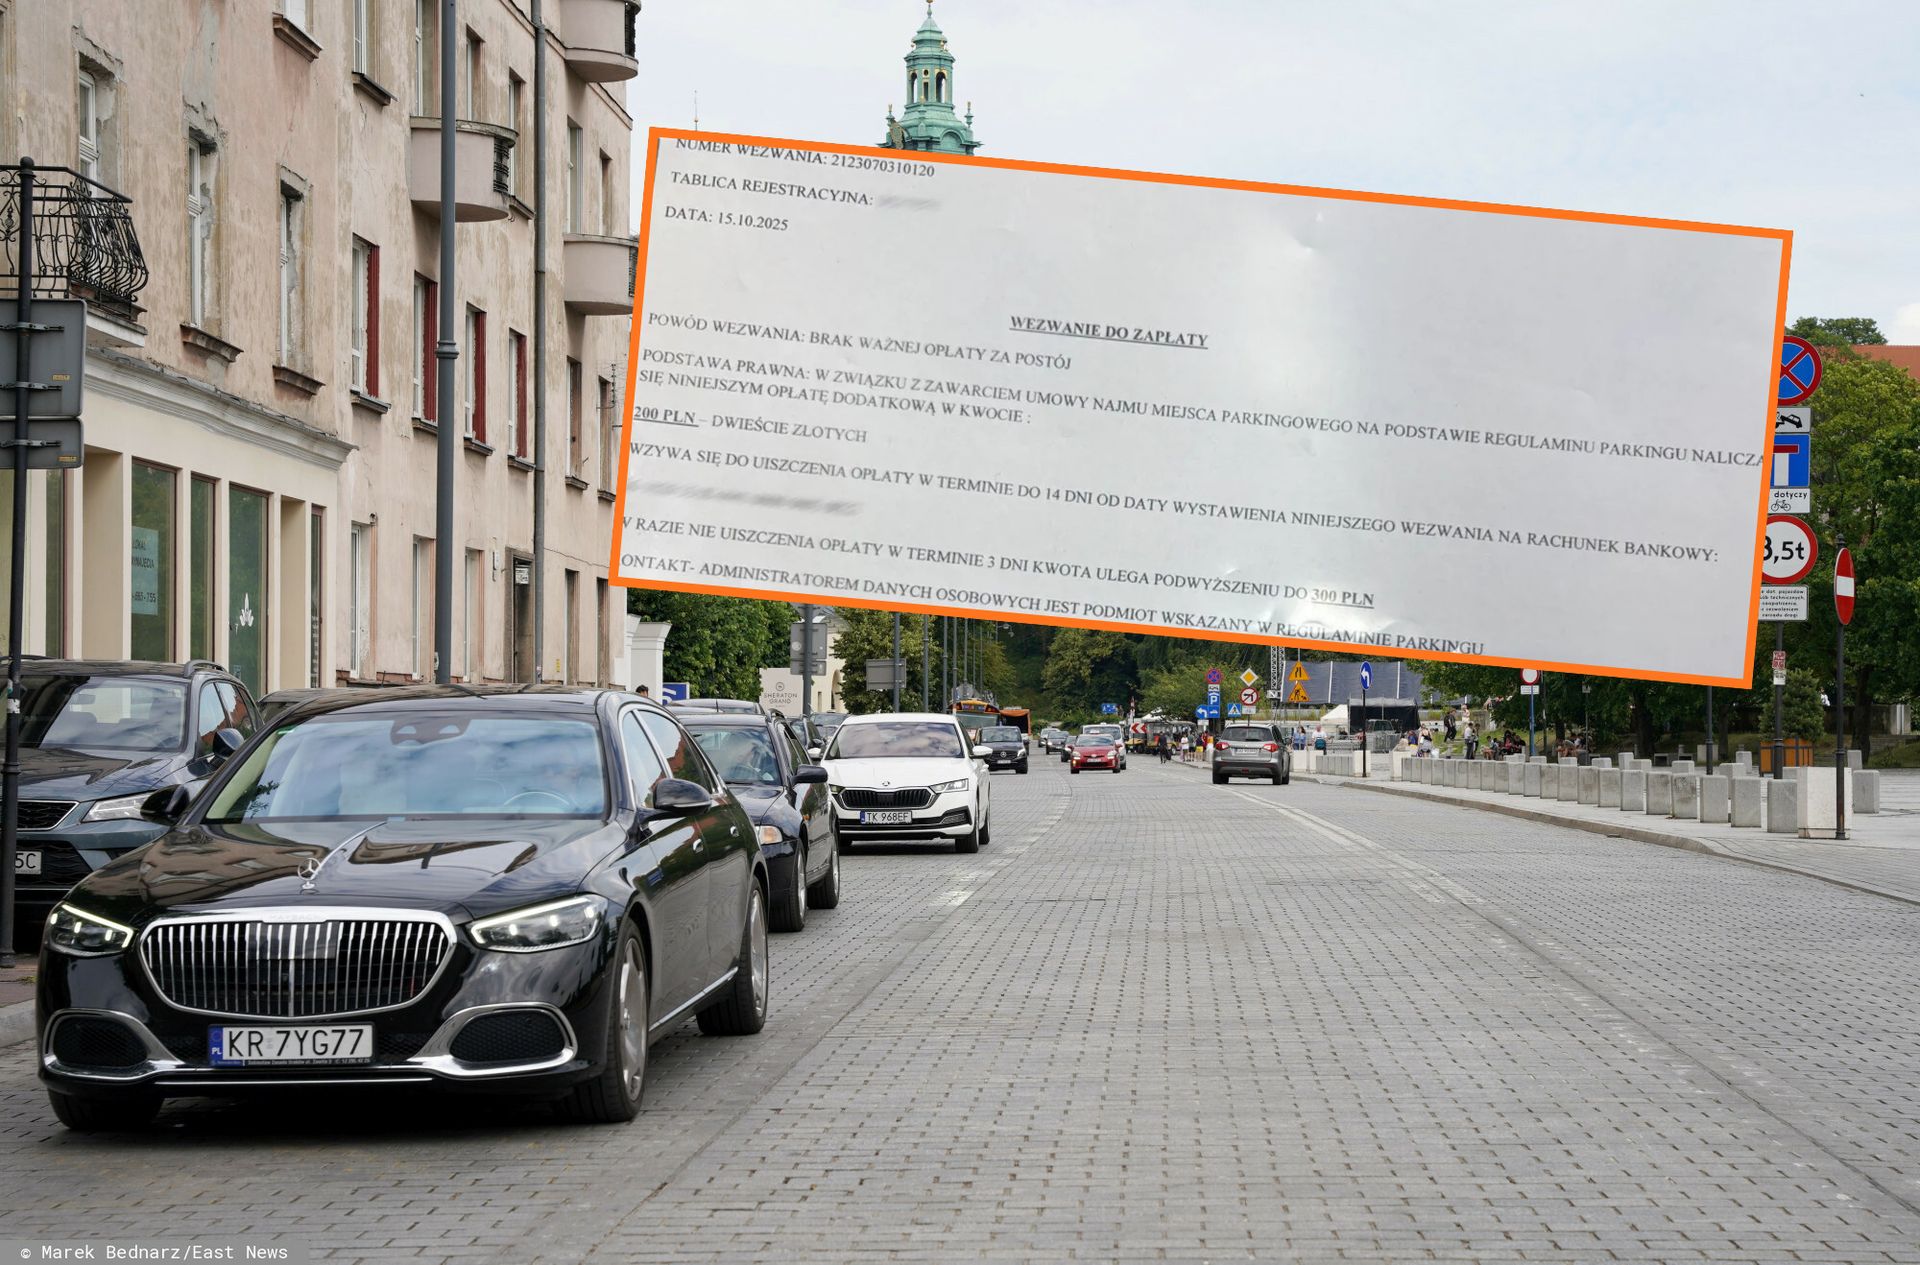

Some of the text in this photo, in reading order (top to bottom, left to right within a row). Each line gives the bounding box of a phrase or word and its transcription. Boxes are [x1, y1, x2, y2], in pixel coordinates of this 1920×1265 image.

[675, 139, 935, 177] NUMER WEZWANIA: 2123070310120
[671, 171, 737, 190] TABLICA
[742, 179, 873, 205] REJESTRACYJNA:
[665, 206, 788, 231] DATA: 15.10.2025
[648, 313, 1071, 370] POWÓD WEZWANIA: BRAK WAŻNEJ OPŁATY ZA POSTÓJ
[1011, 316, 1208, 348] WEZWANIE DO ZAPŁATY
[639, 370, 664, 386] SIĘ
[668, 373, 763, 395] NINIEJSZYM
[767, 384, 829, 405] OPŁATĘ
[833, 391, 936, 416] DODATKOWĄ
[942, 402, 956, 414] W
[960, 404, 1023, 422] KWOCIE
[643, 349, 731, 371] PODSTAWA
[736, 360, 810, 379] PRAWNA:
[816, 369, 830, 381] W
[833, 371, 907, 389] ZWIĄZKU
[910, 378, 921, 391] Z
[924, 380, 1021, 401] ZAWARCIEM
[1026, 391, 1089, 408] UMOWY
[1093, 397, 1148, 415] NAJMU
[1152, 404, 1216, 421] MIEJSCA
[1222, 410, 1353, 433] PARKINGOWEGO
[1357, 421, 1379, 435] NA
[1384, 424, 1480, 443] PODSTAWIE
[1485, 432, 1595, 453] REGULAMINU
[1600, 442, 1687, 460] PARKINGU
[634, 406, 659, 420] 200
[663, 409, 697, 424] PLN
[712, 415, 789, 434] DWIEŚCIE
[792, 424, 868, 443] ZŁOTYCH
[631, 443, 1718, 562] WZYWA SIĘ DO UISZCZENIA OPŁATY W TERMINIE DO 14 DNI OD DATY WYSTAWIENIA NINIEJSZEGO WEZWANIA NA RACHUNEK BANKOWY:
[1774, 490, 1808, 500] dotyczy
[636, 518, 684, 534] RAZIE
[688, 523, 716, 538] NIE
[720, 527, 815, 549] UISZCZENIA
[819, 538, 883, 556] OPŁATY
[888, 545, 903, 557] W
[907, 547, 984, 567] TERMINIE
[987, 556, 995, 568] 3
[1000, 557, 1028, 572] DNI
[1033, 561, 1091, 579] KWOTA
[1097, 568, 1149, 584] ULEGA
[1154, 573, 1280, 597] PODWYŻSZENIU
[1284, 585, 1307, 599] DO
[1311, 588, 1337, 602] 300
[1341, 591, 1375, 607] PLN
[699, 563, 859, 591] ADMINISTRATOREM
[863, 580, 932, 599] DANYCH
[936, 588, 1041, 610] OSOBOWYCH
[1044, 600, 1080, 614] JEST
[1083, 603, 1157, 622] PODMIOT
[1162, 611, 1253, 632] WSKAZANY
[1257, 621, 1273, 633] W
[1276, 623, 1392, 646] REGULAMINIE
[1396, 635, 1484, 655] PARKINGU
[1210, 695, 1218, 705] P
[867, 812, 909, 822] TK 968EF
[229, 1029, 364, 1057] KR 7YG77
